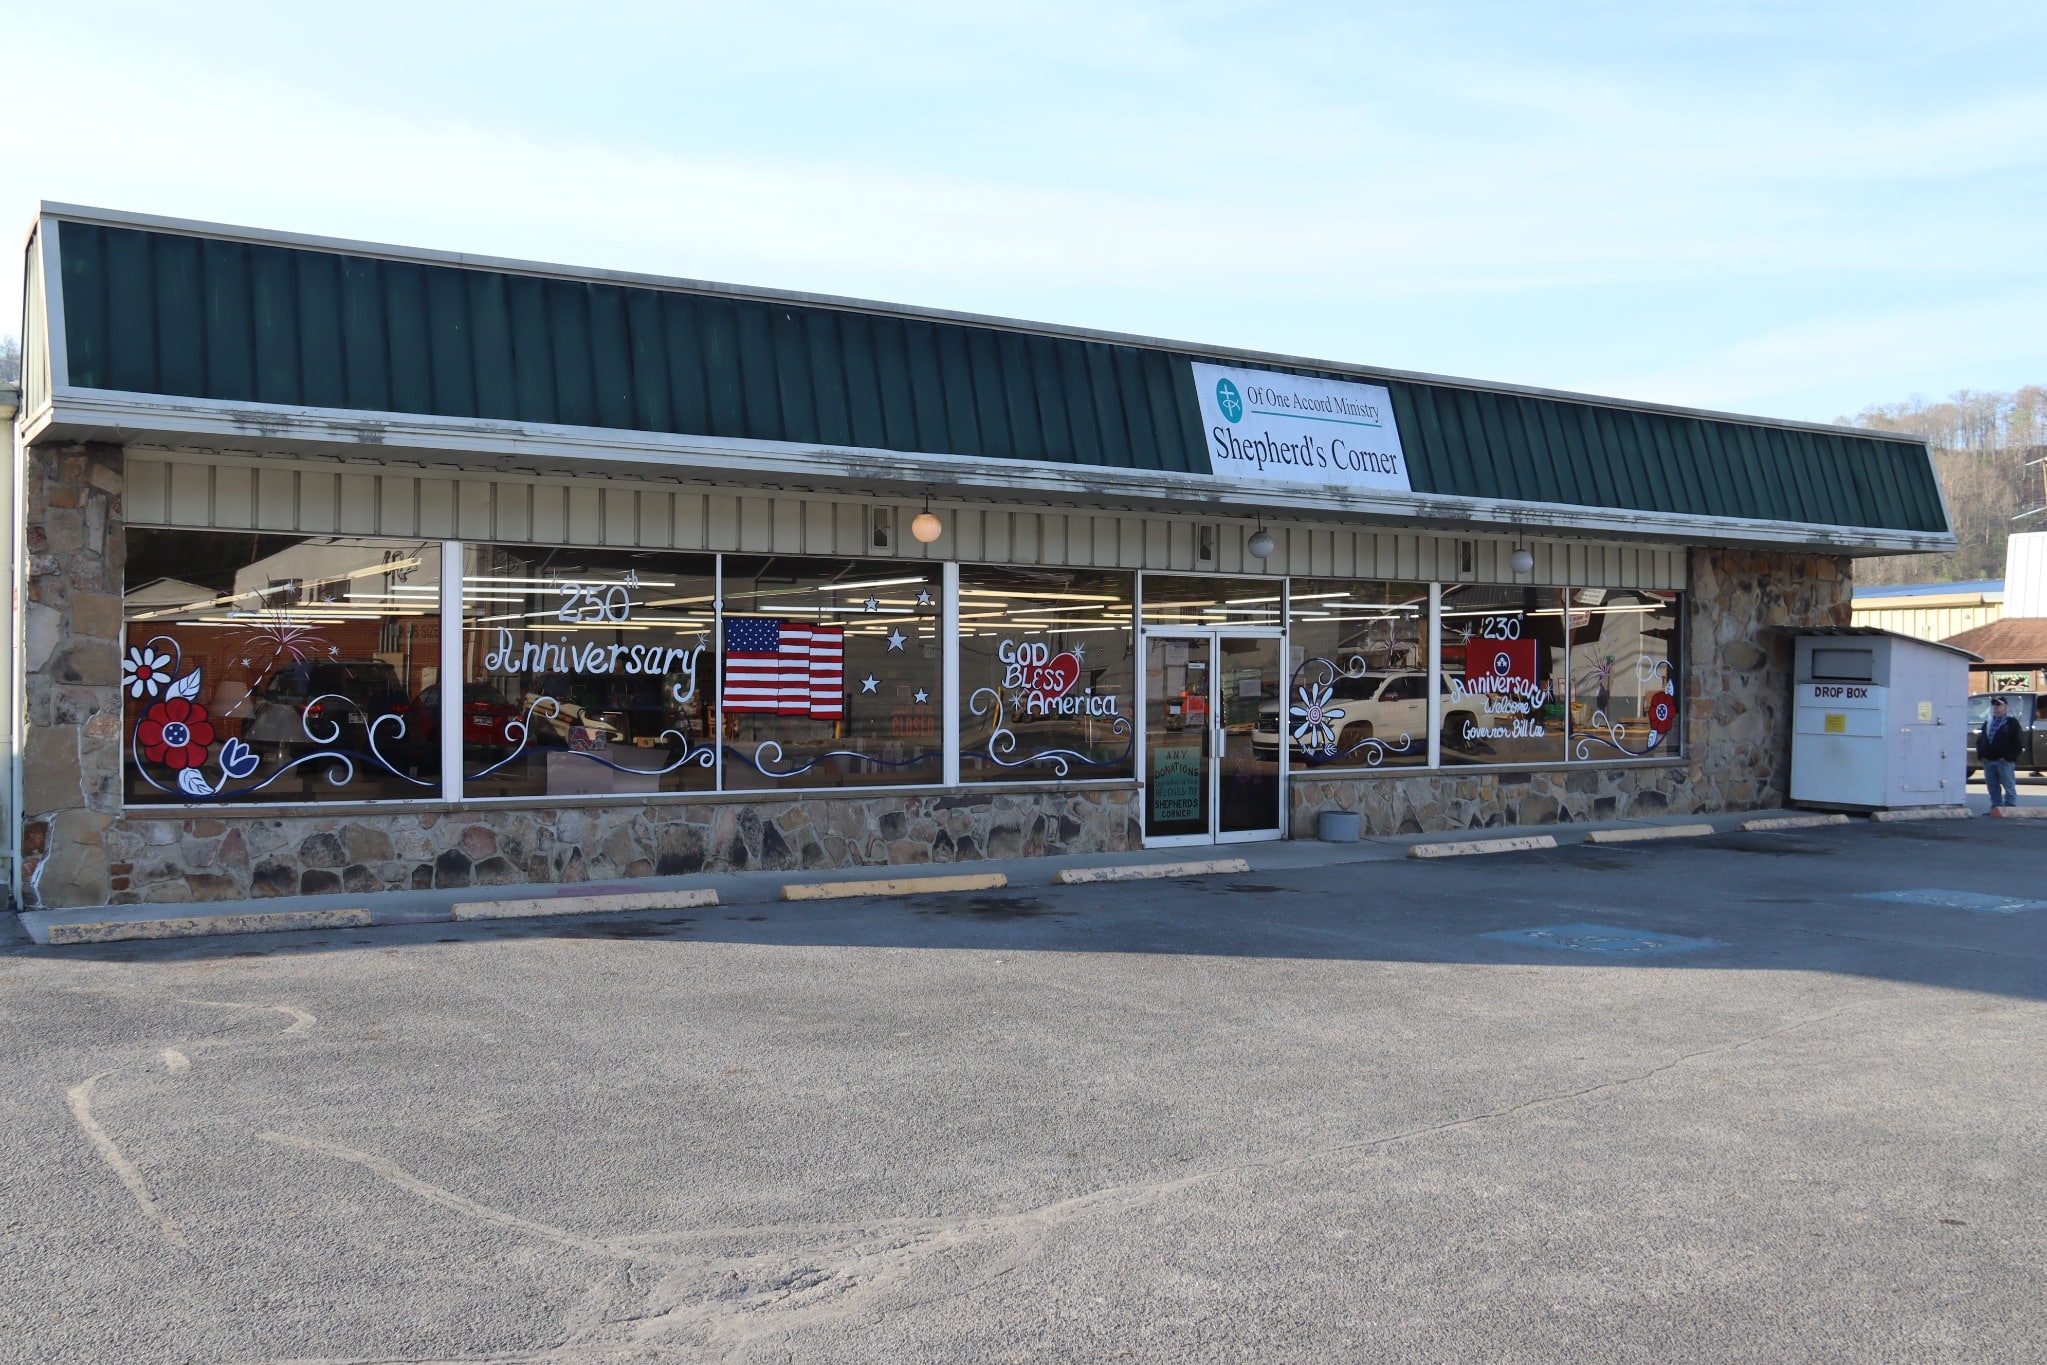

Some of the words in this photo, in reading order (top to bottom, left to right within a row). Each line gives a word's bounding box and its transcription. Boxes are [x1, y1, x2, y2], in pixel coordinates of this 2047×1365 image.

[1247, 386, 1264, 405] Of
[1266, 388, 1290, 408] One
[1293, 393, 1332, 413] Accord
[1335, 396, 1379, 424] Ministry
[1212, 426, 1327, 471] Shepherd's
[1331, 438, 1398, 475] Corner
[399, 624, 418, 638] PLS
[998, 639, 1049, 667] GOD
[484, 626, 706, 703] Anniversary
[1451, 670, 1547, 709] Anniversary
[1814, 686, 1843, 698] DROP
[1846, 687, 1868, 699] BOX
[1026, 687, 1119, 716] America
[1480, 696, 1531, 714] Welcome
[892, 716, 935, 737] CLOSED
[1462, 719, 1511, 740] Governor
[1512, 718, 1527, 738] Bill
[1528, 717, 1545, 738] Lee
[1166, 750, 1187, 760] ANY
[1154, 761, 1199, 779] DONATIONS
[1155, 787, 1186, 797] BELONGS
[1188, 786, 1198, 796] TO
[1161, 809, 1192, 818] CORNER
